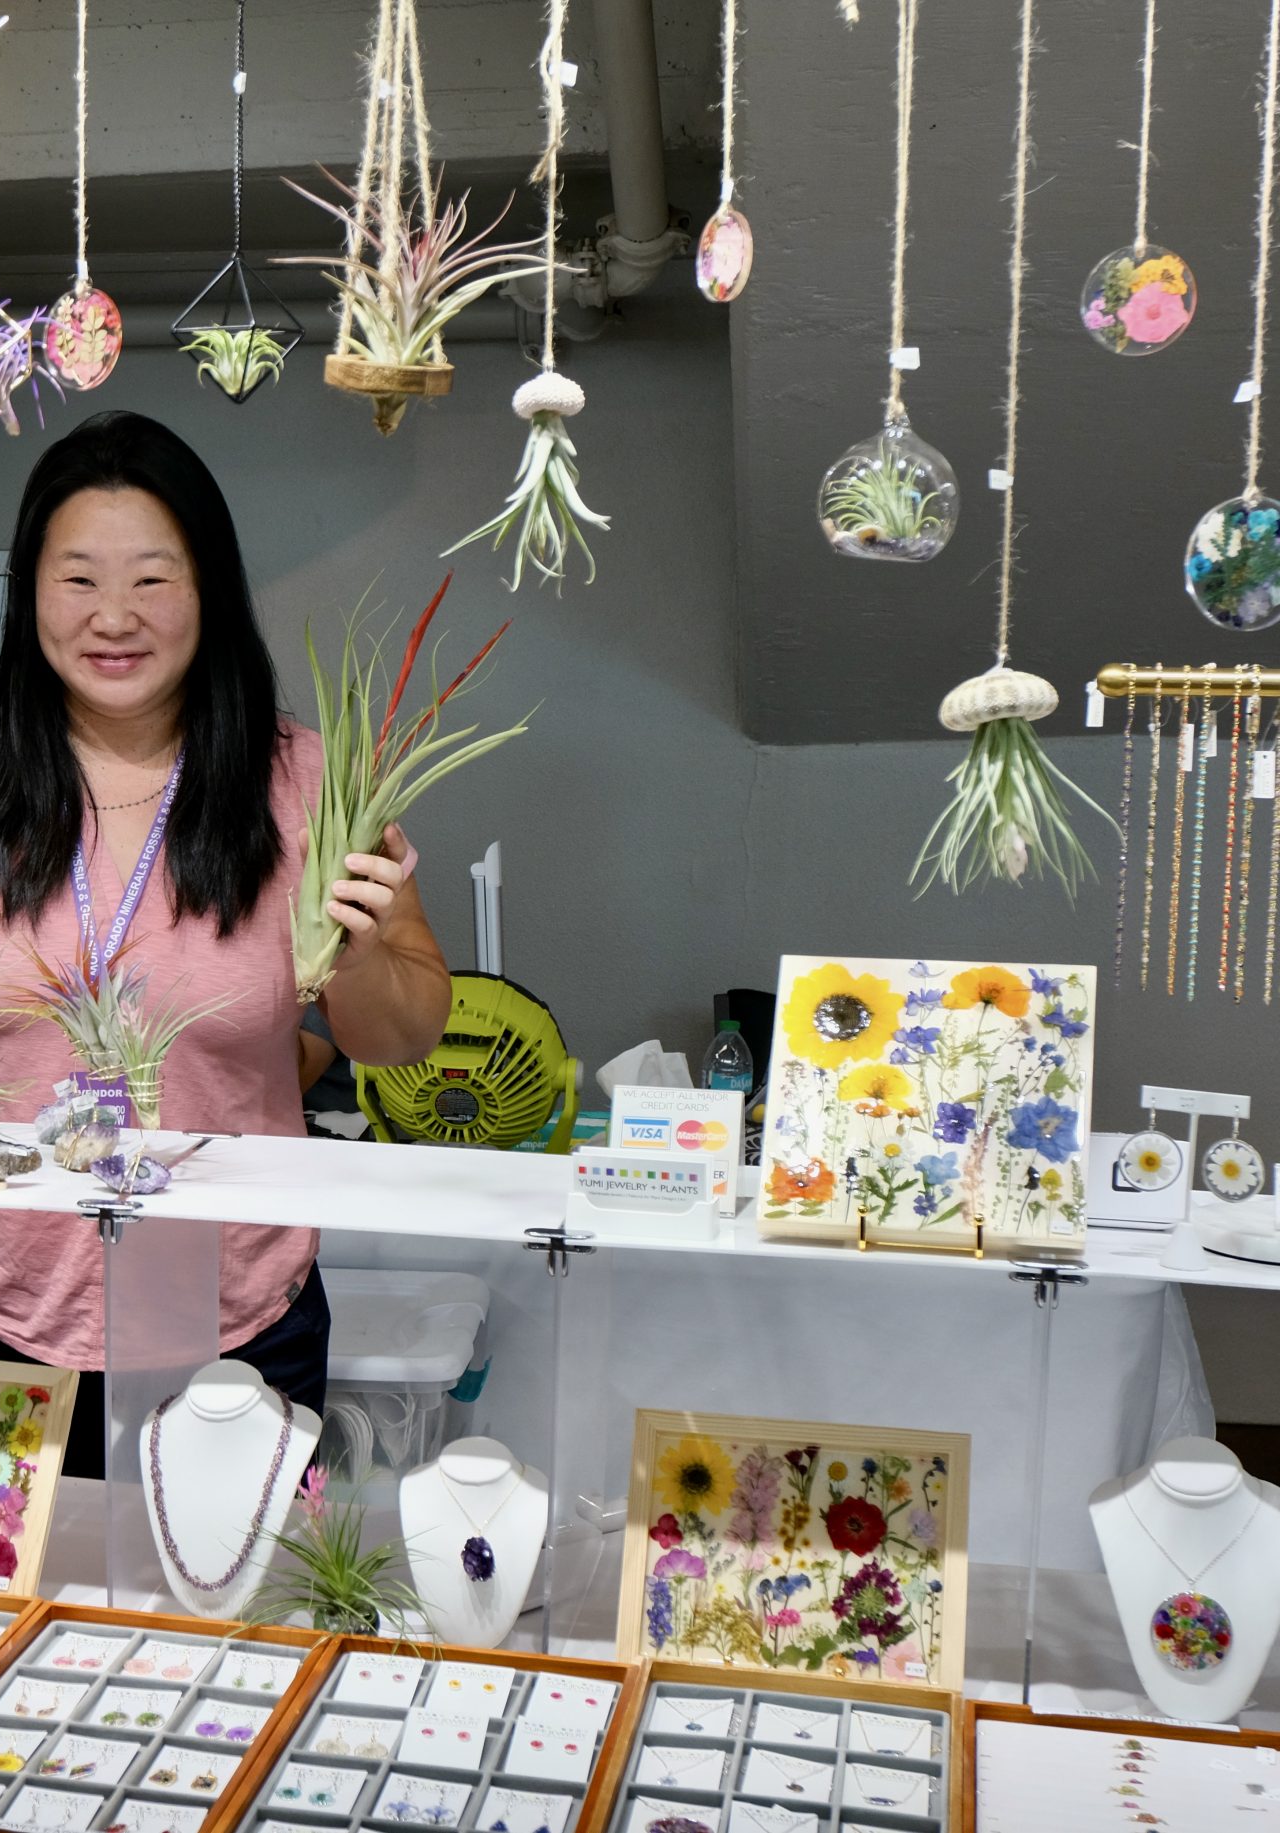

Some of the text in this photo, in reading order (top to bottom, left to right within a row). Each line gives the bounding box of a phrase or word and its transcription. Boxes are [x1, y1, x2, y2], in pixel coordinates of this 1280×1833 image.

[121, 863, 148, 916] MINERALS
[143, 816, 168, 861] FOSSILS
[161, 807, 170, 815] &
[78, 893, 89, 902] &
[78, 1089, 123, 1097] VENDOR
[623, 1089, 729, 1102] WE ACCEPT ALL MAJOR
[641, 1101, 710, 1112] CREDIT CARDS
[630, 1127, 728, 1140] VISA MasterCard
[579, 1179, 604, 1188] YUMI
[606, 1181, 648, 1191] JEWELRY
[660, 1185, 699, 1195] PLANTS
